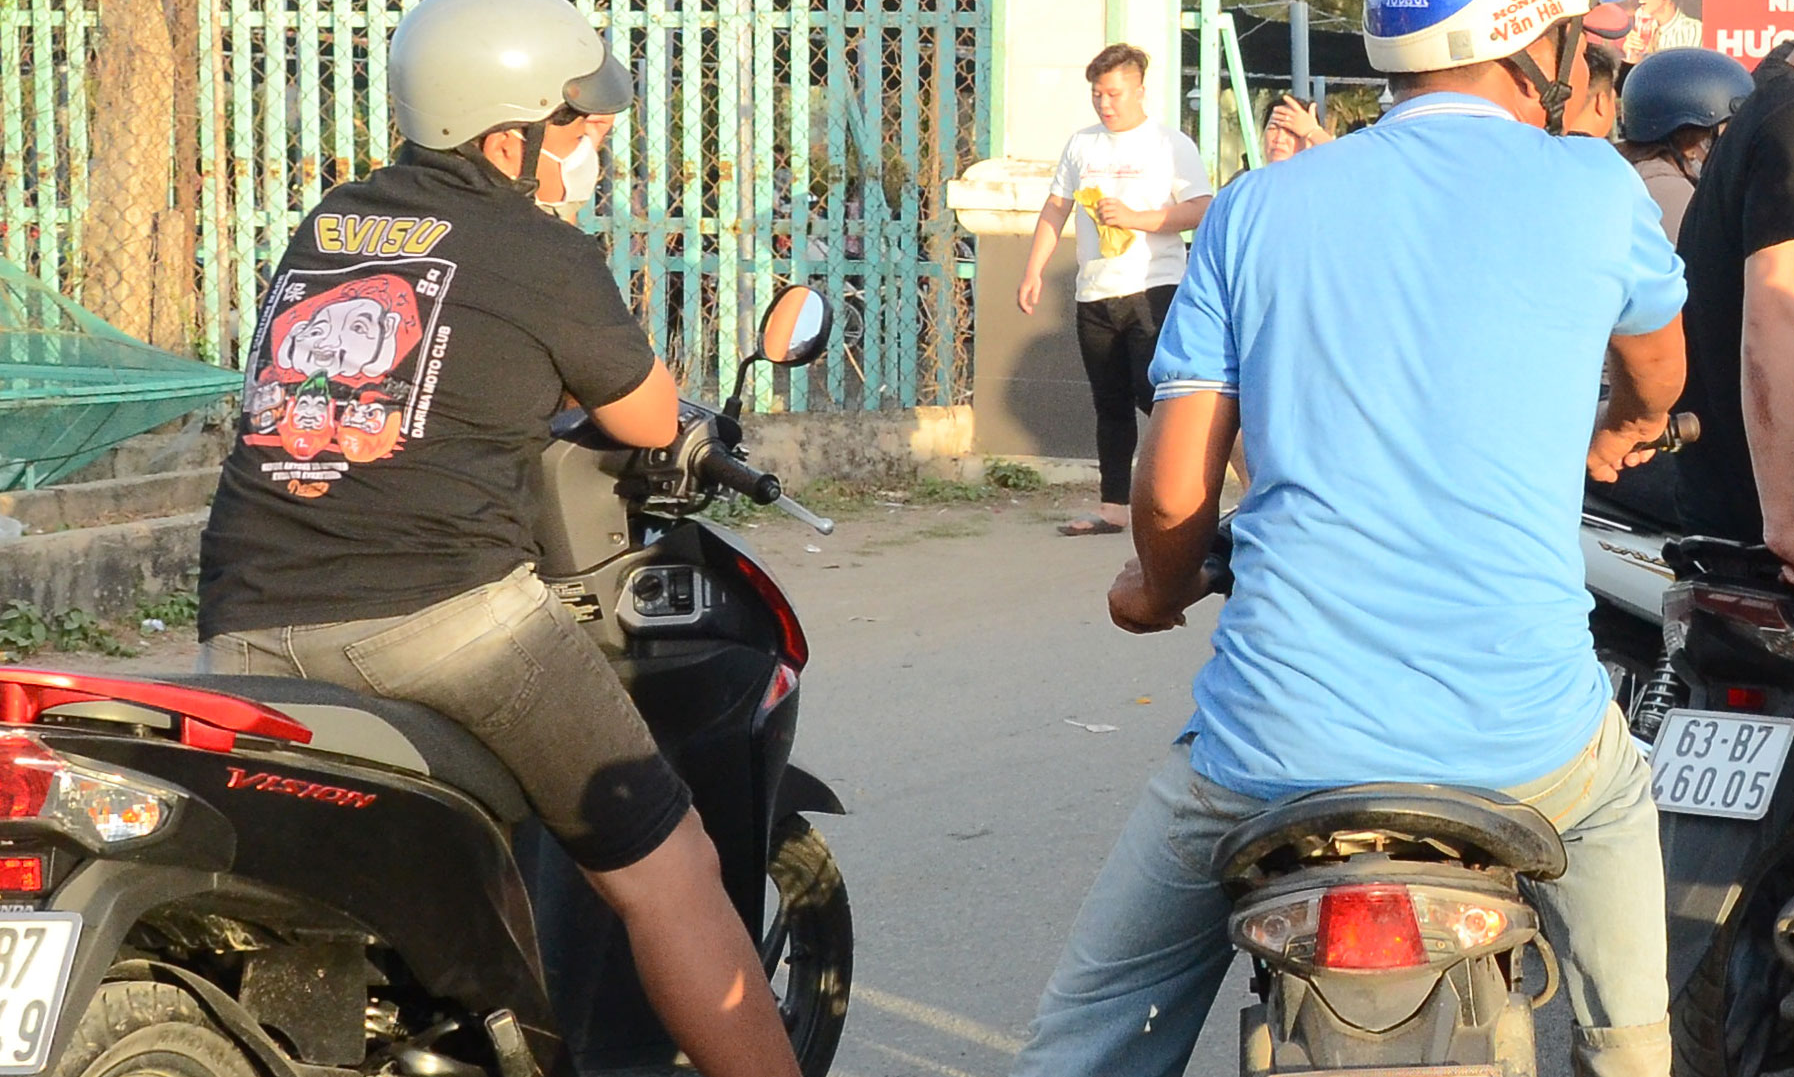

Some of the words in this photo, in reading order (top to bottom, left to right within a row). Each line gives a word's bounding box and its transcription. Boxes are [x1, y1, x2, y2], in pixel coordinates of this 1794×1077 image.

[1494, 16, 1534, 41] Văn
[314, 213, 452, 257] EVISU
[431, 325, 452, 359] CLUB
[423, 358, 443, 395] MOTO
[1675, 719, 1775, 764] 63-B7
[225, 766, 378, 809] VISION
[1651, 762, 1772, 811] 460.05
